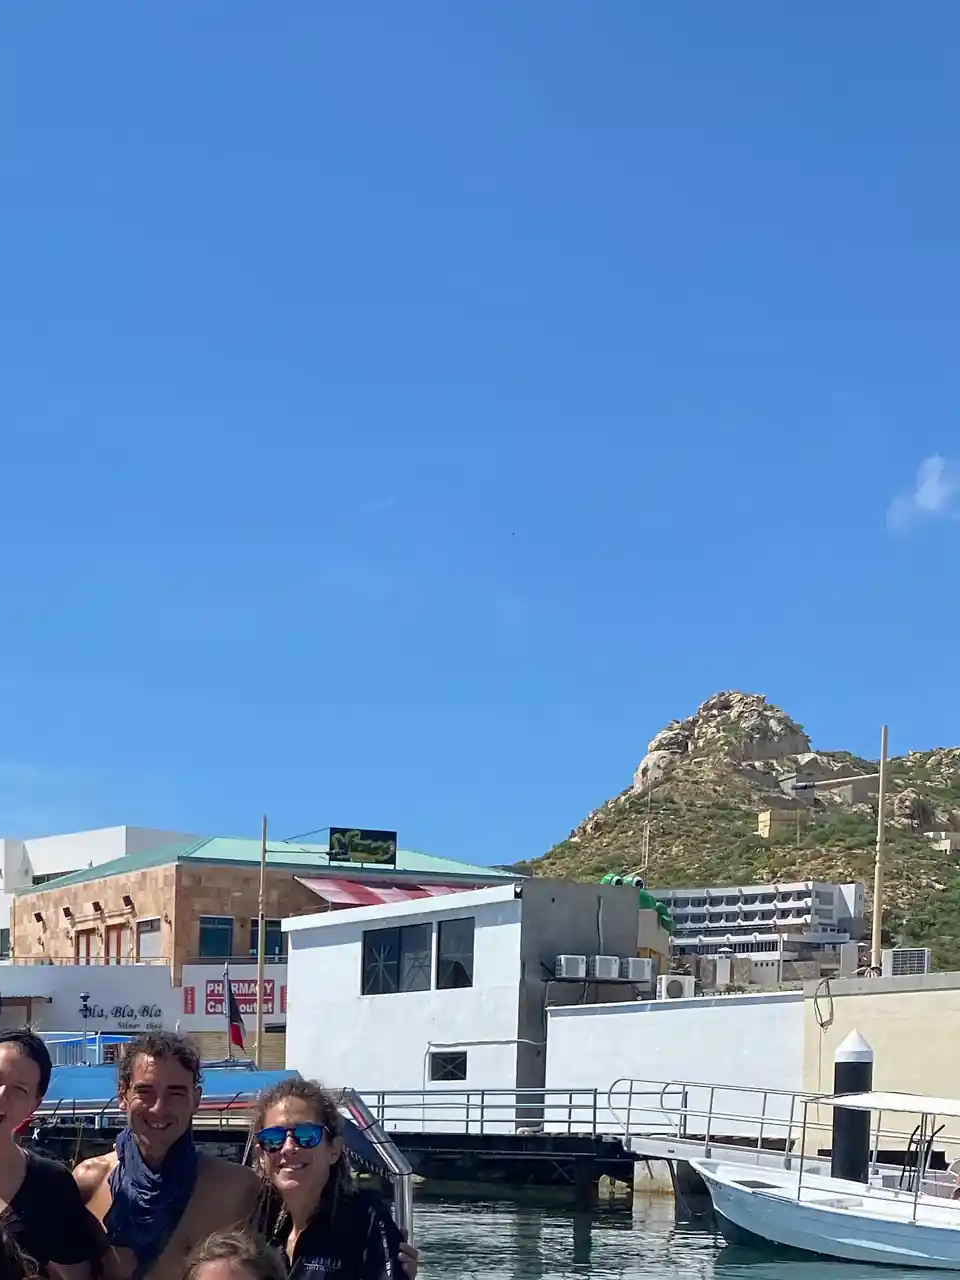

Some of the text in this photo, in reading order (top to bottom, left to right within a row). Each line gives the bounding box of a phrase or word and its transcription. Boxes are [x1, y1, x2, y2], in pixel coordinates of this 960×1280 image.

[207, 983, 273, 994] PHRMAY
[139, 1004, 162, 1018] Bla
[239, 1001, 273, 1012] outet
